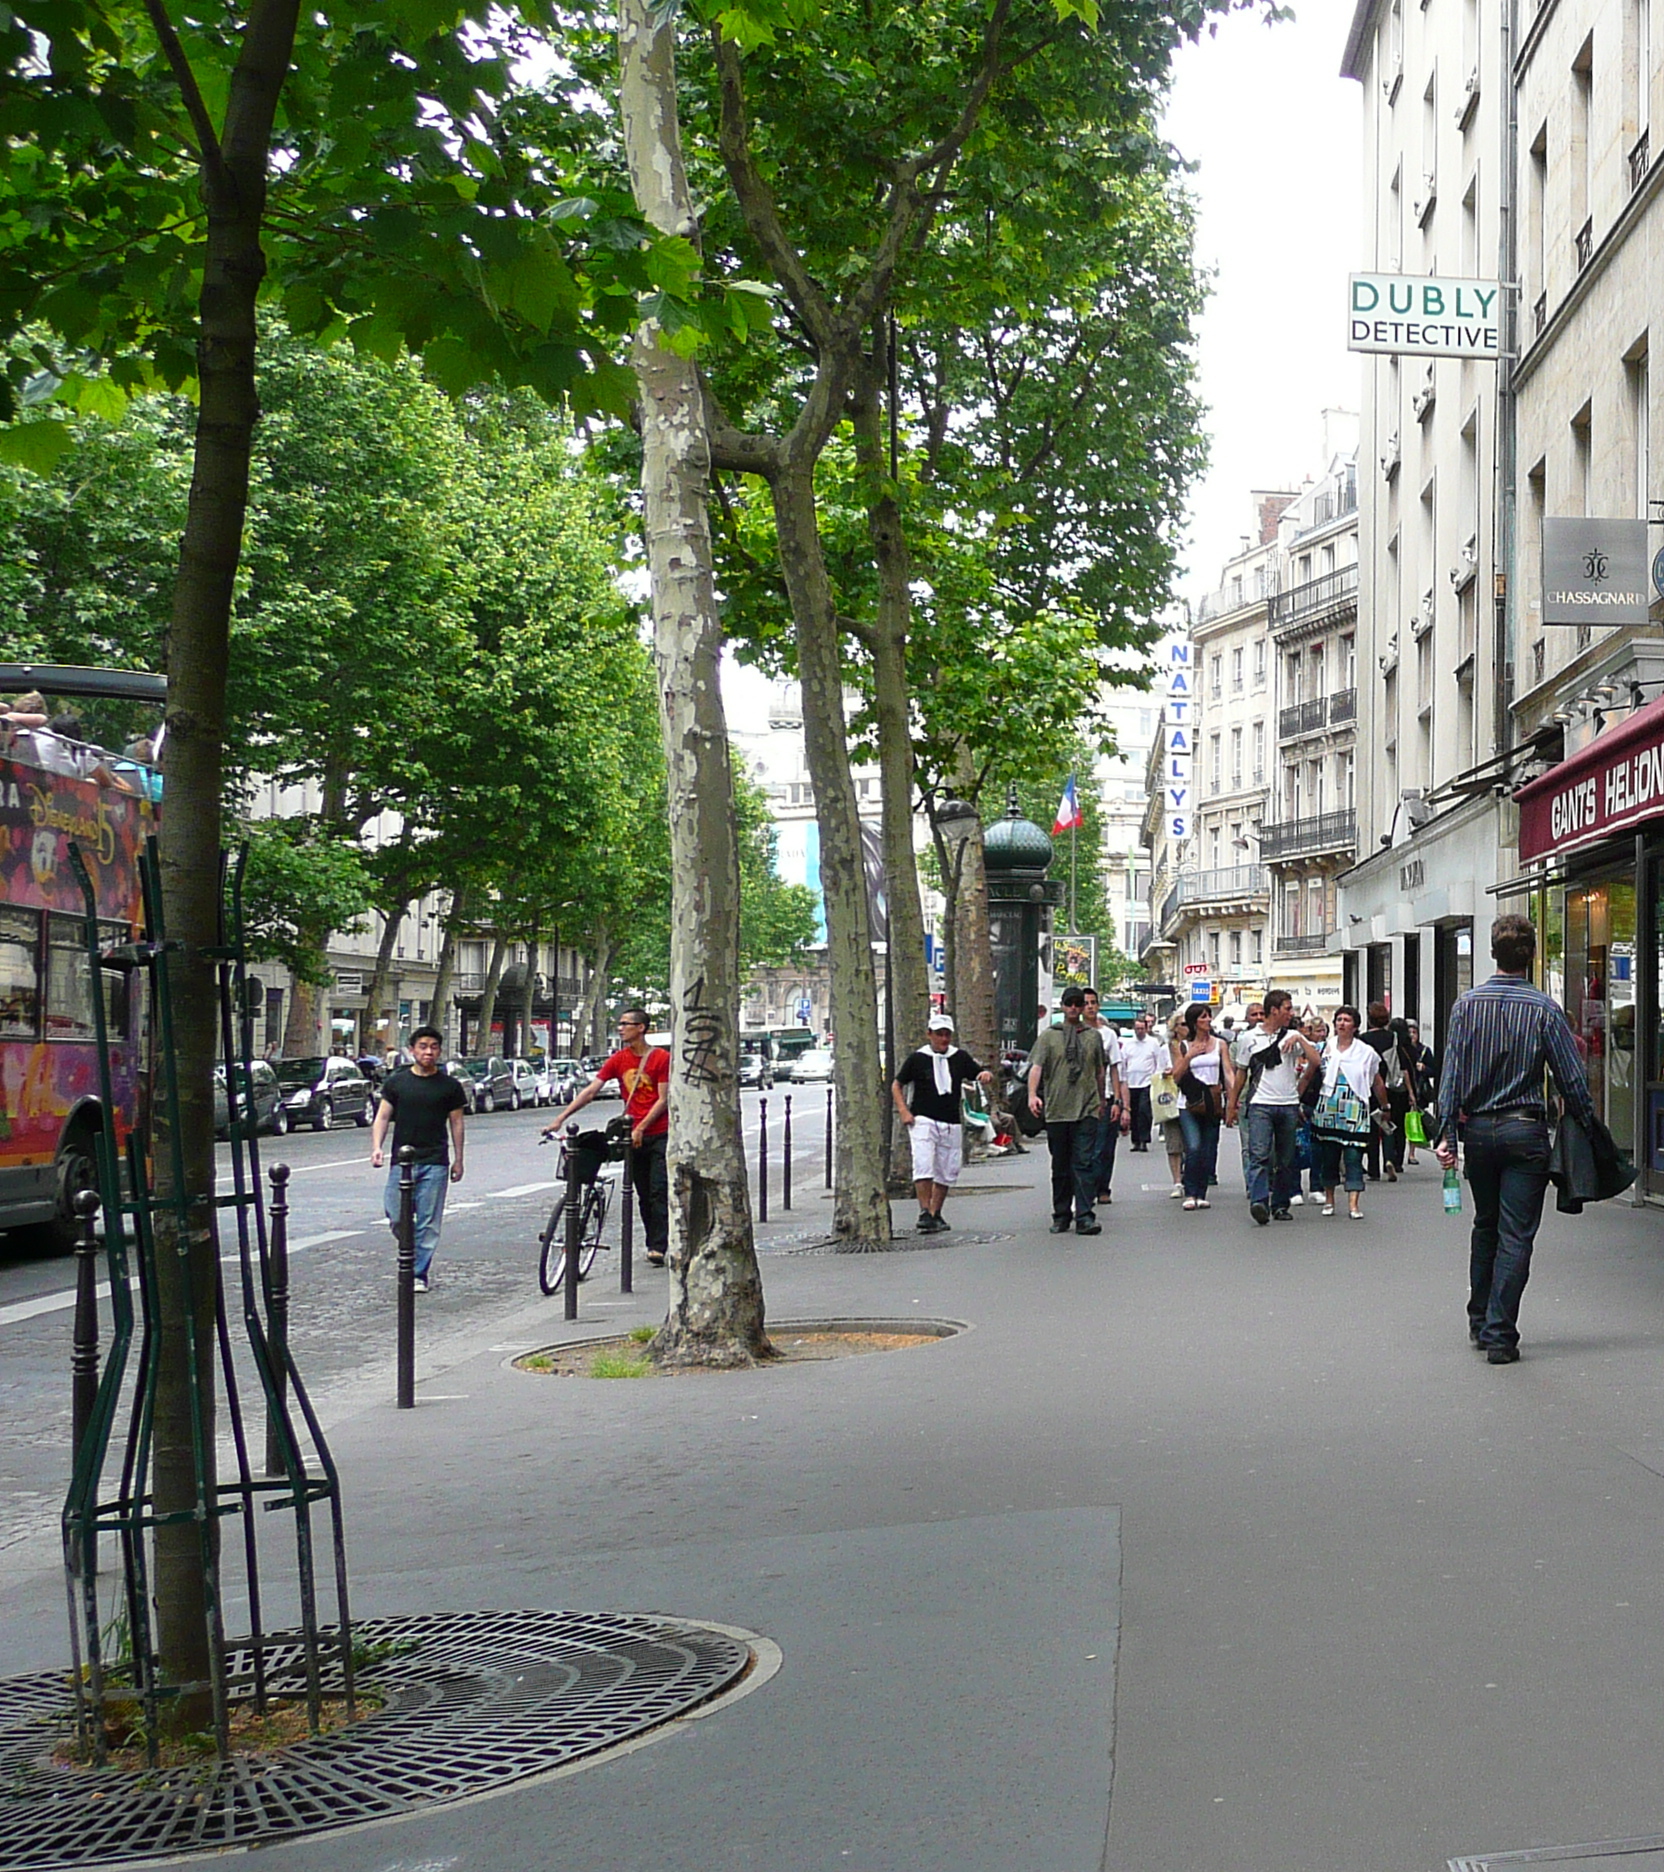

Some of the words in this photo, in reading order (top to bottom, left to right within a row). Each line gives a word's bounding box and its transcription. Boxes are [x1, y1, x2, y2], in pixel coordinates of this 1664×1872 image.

[1352, 281, 1497, 319] DUBLY
[1547, 591, 1645, 605] CHASSAGNARD
[1170, 645, 1188, 836] NATALYS
[1551, 777, 1596, 840] GANTS
